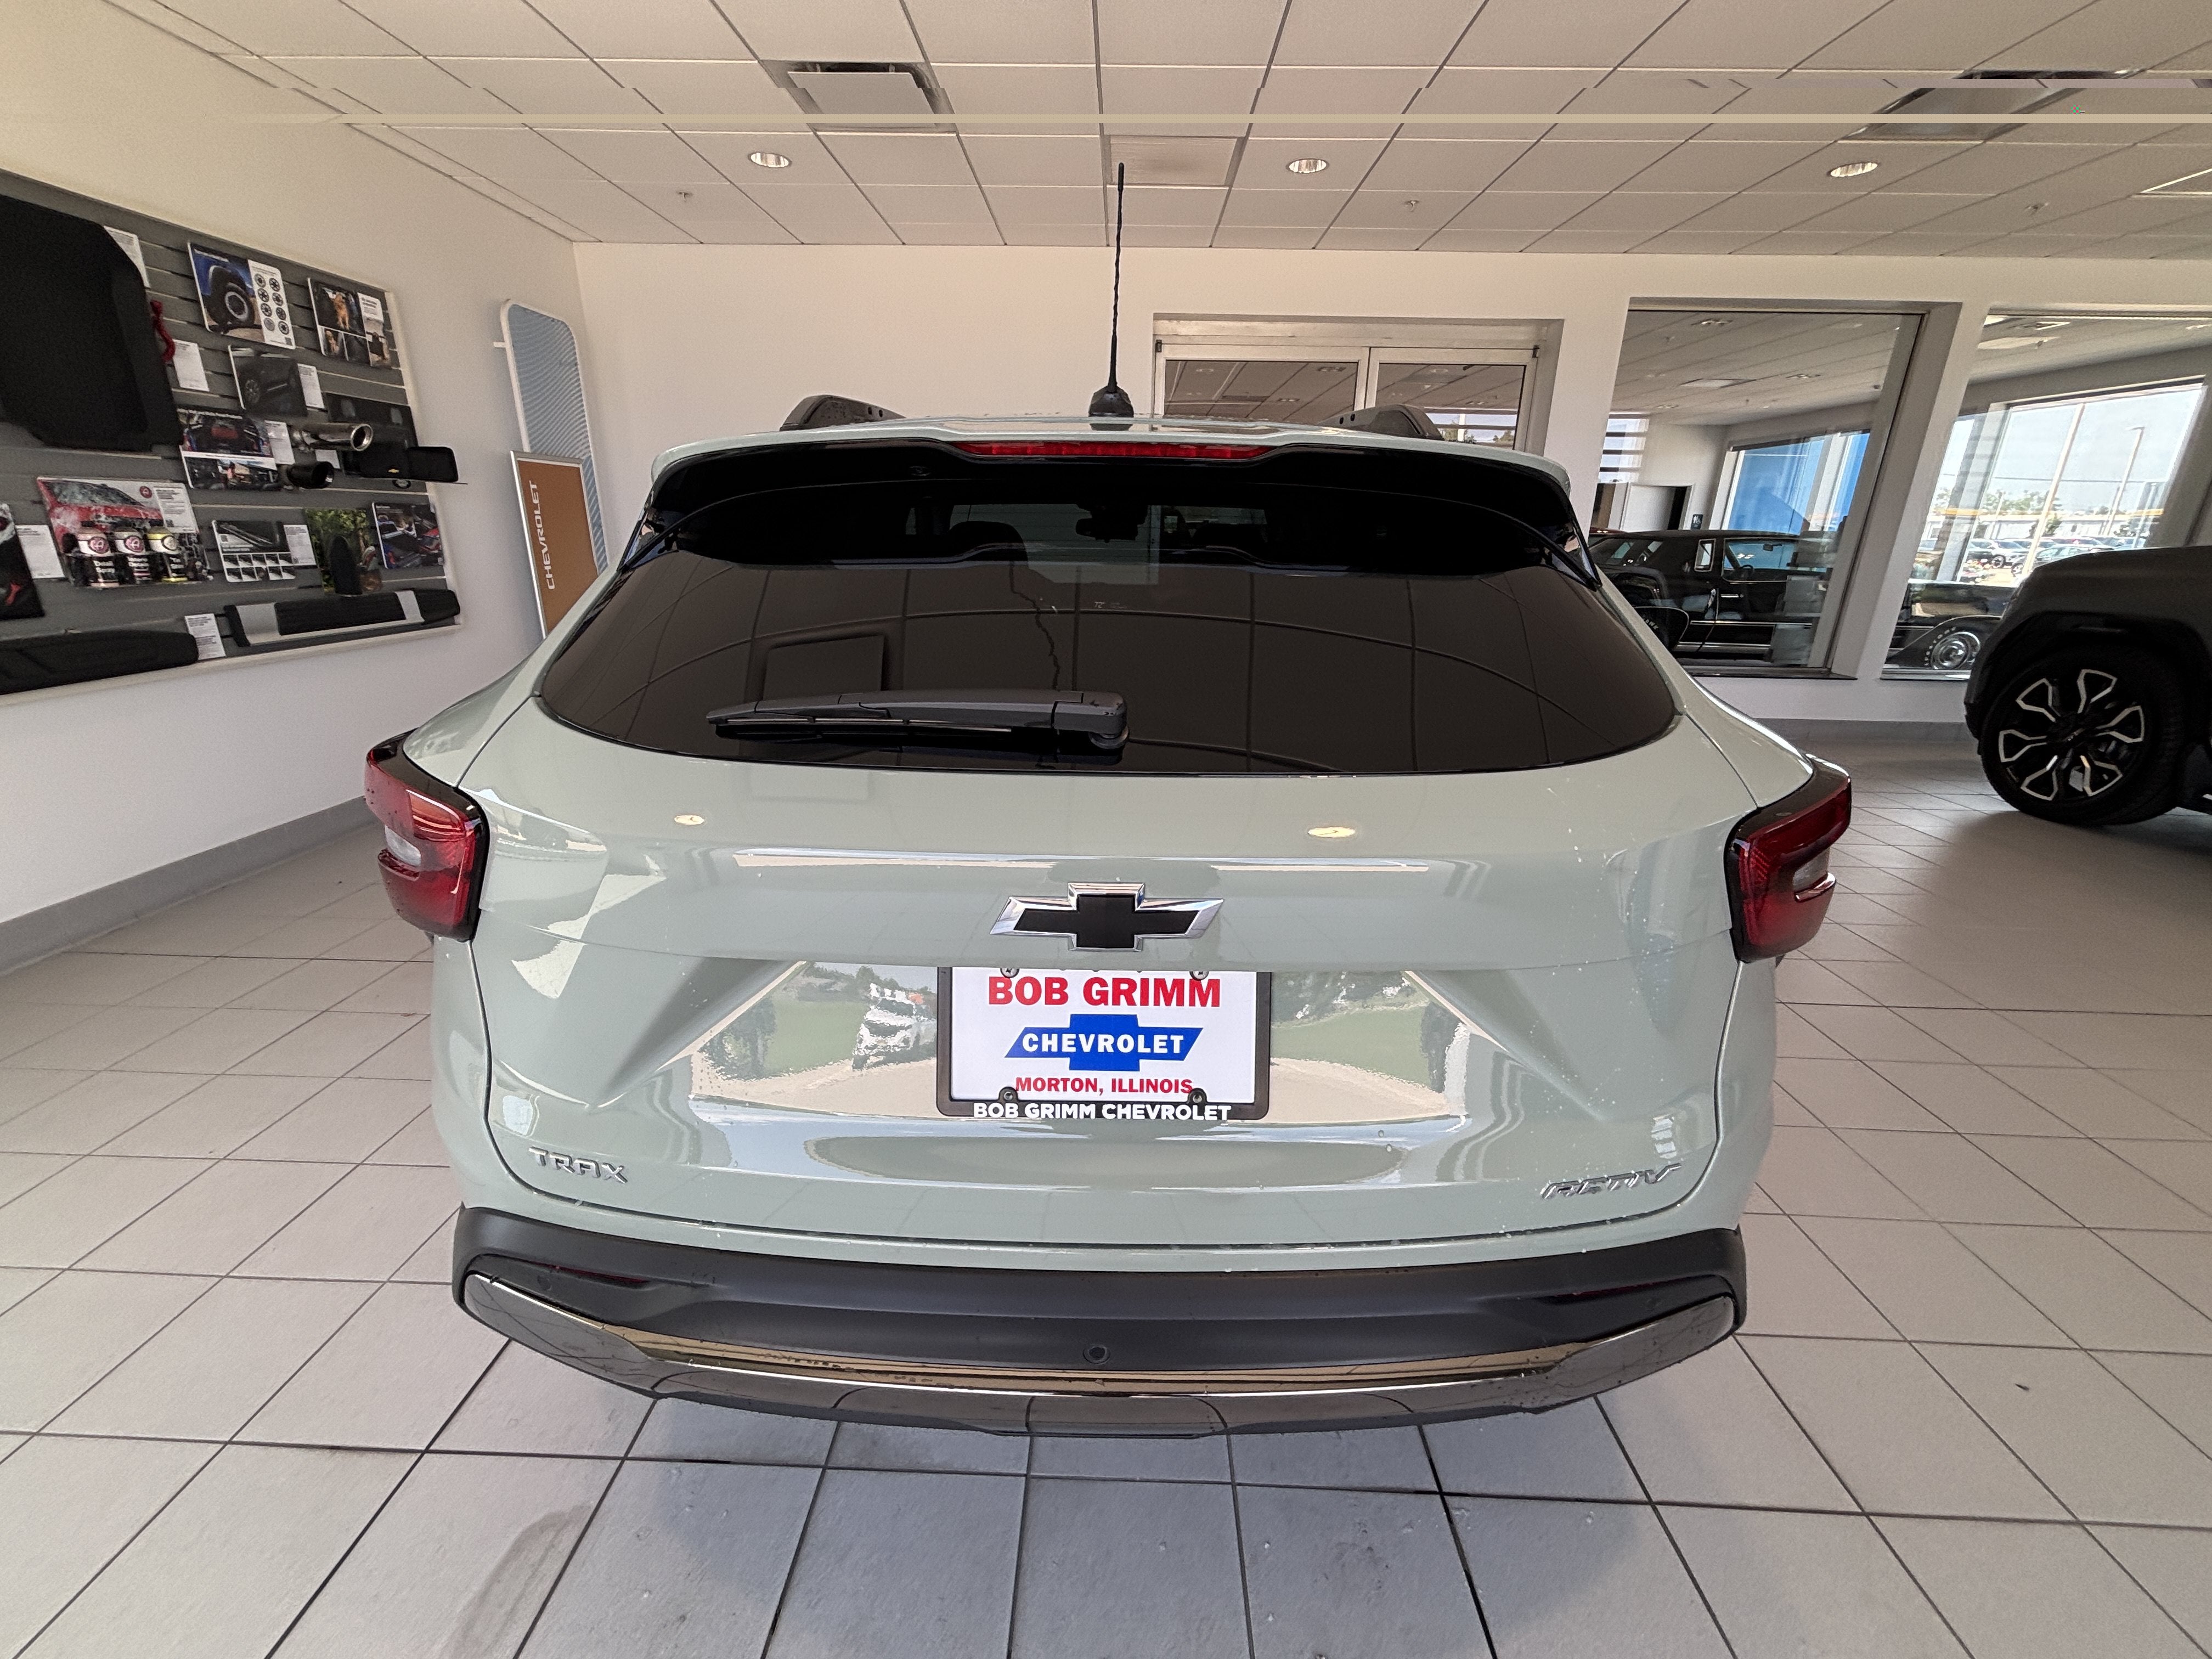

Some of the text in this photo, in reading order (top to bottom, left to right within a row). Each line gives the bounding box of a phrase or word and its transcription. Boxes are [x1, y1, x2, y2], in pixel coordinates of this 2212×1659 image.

[529, 480, 555, 590] CHEVROLET
[989, 977, 1220, 1007] BOB GRIMM
[1023, 1034, 1184, 1054] CHEVROLET
[1015, 1077, 1193, 1096] MORTON, ILLINOIS
[974, 1102, 1231, 1121] BOB GRIMM CHEVROLET
[529, 1146, 628, 1184] TRAX
[1541, 1163, 1681, 1199] ACTIV
